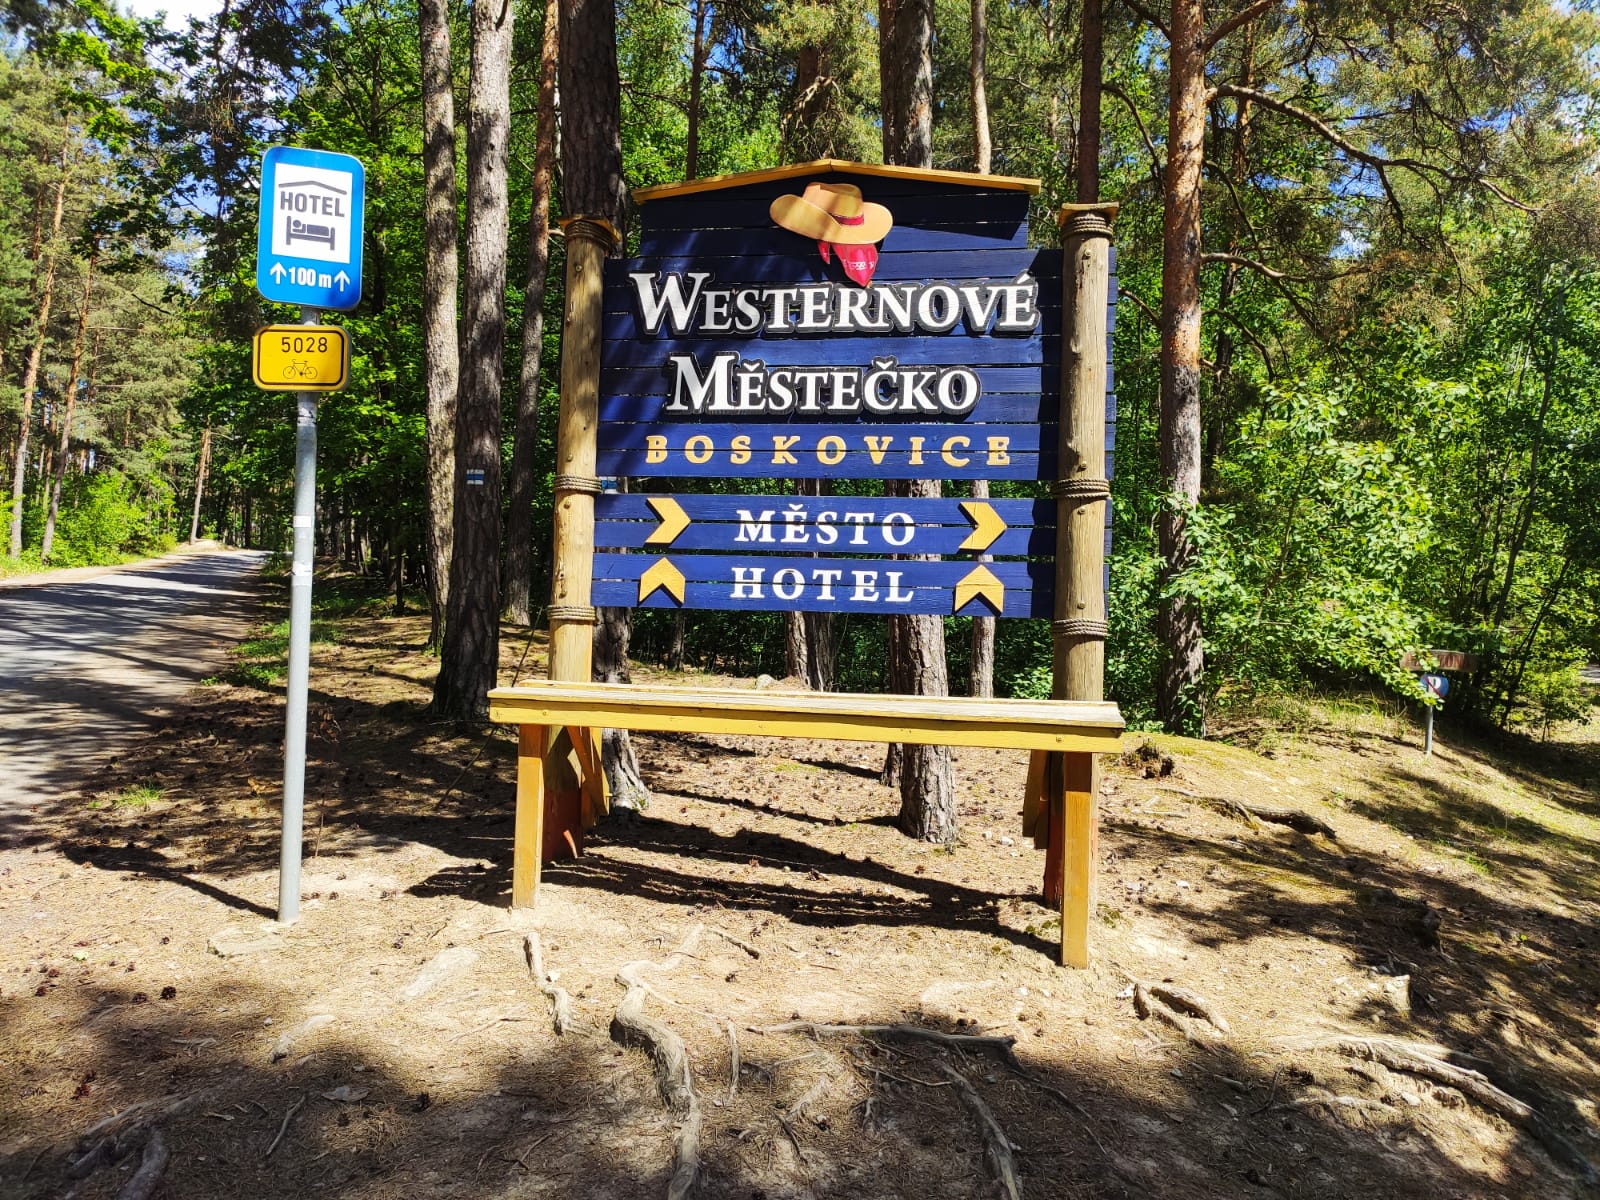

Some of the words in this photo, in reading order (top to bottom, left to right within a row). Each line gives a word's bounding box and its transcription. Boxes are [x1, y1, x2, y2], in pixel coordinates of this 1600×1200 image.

[280, 191, 345, 217] HOTEL
[288, 266, 316, 288] 100
[318, 273, 332, 289] m
[629, 271, 1039, 332] WESTERNOVÉ
[281, 336, 328, 353] 5028
[666, 354, 980, 412] MĚSTEČKO
[645, 435, 1011, 467] BOSKOVICE
[734, 503, 916, 546] MĚSTO
[730, 567, 915, 602] HOTEL
